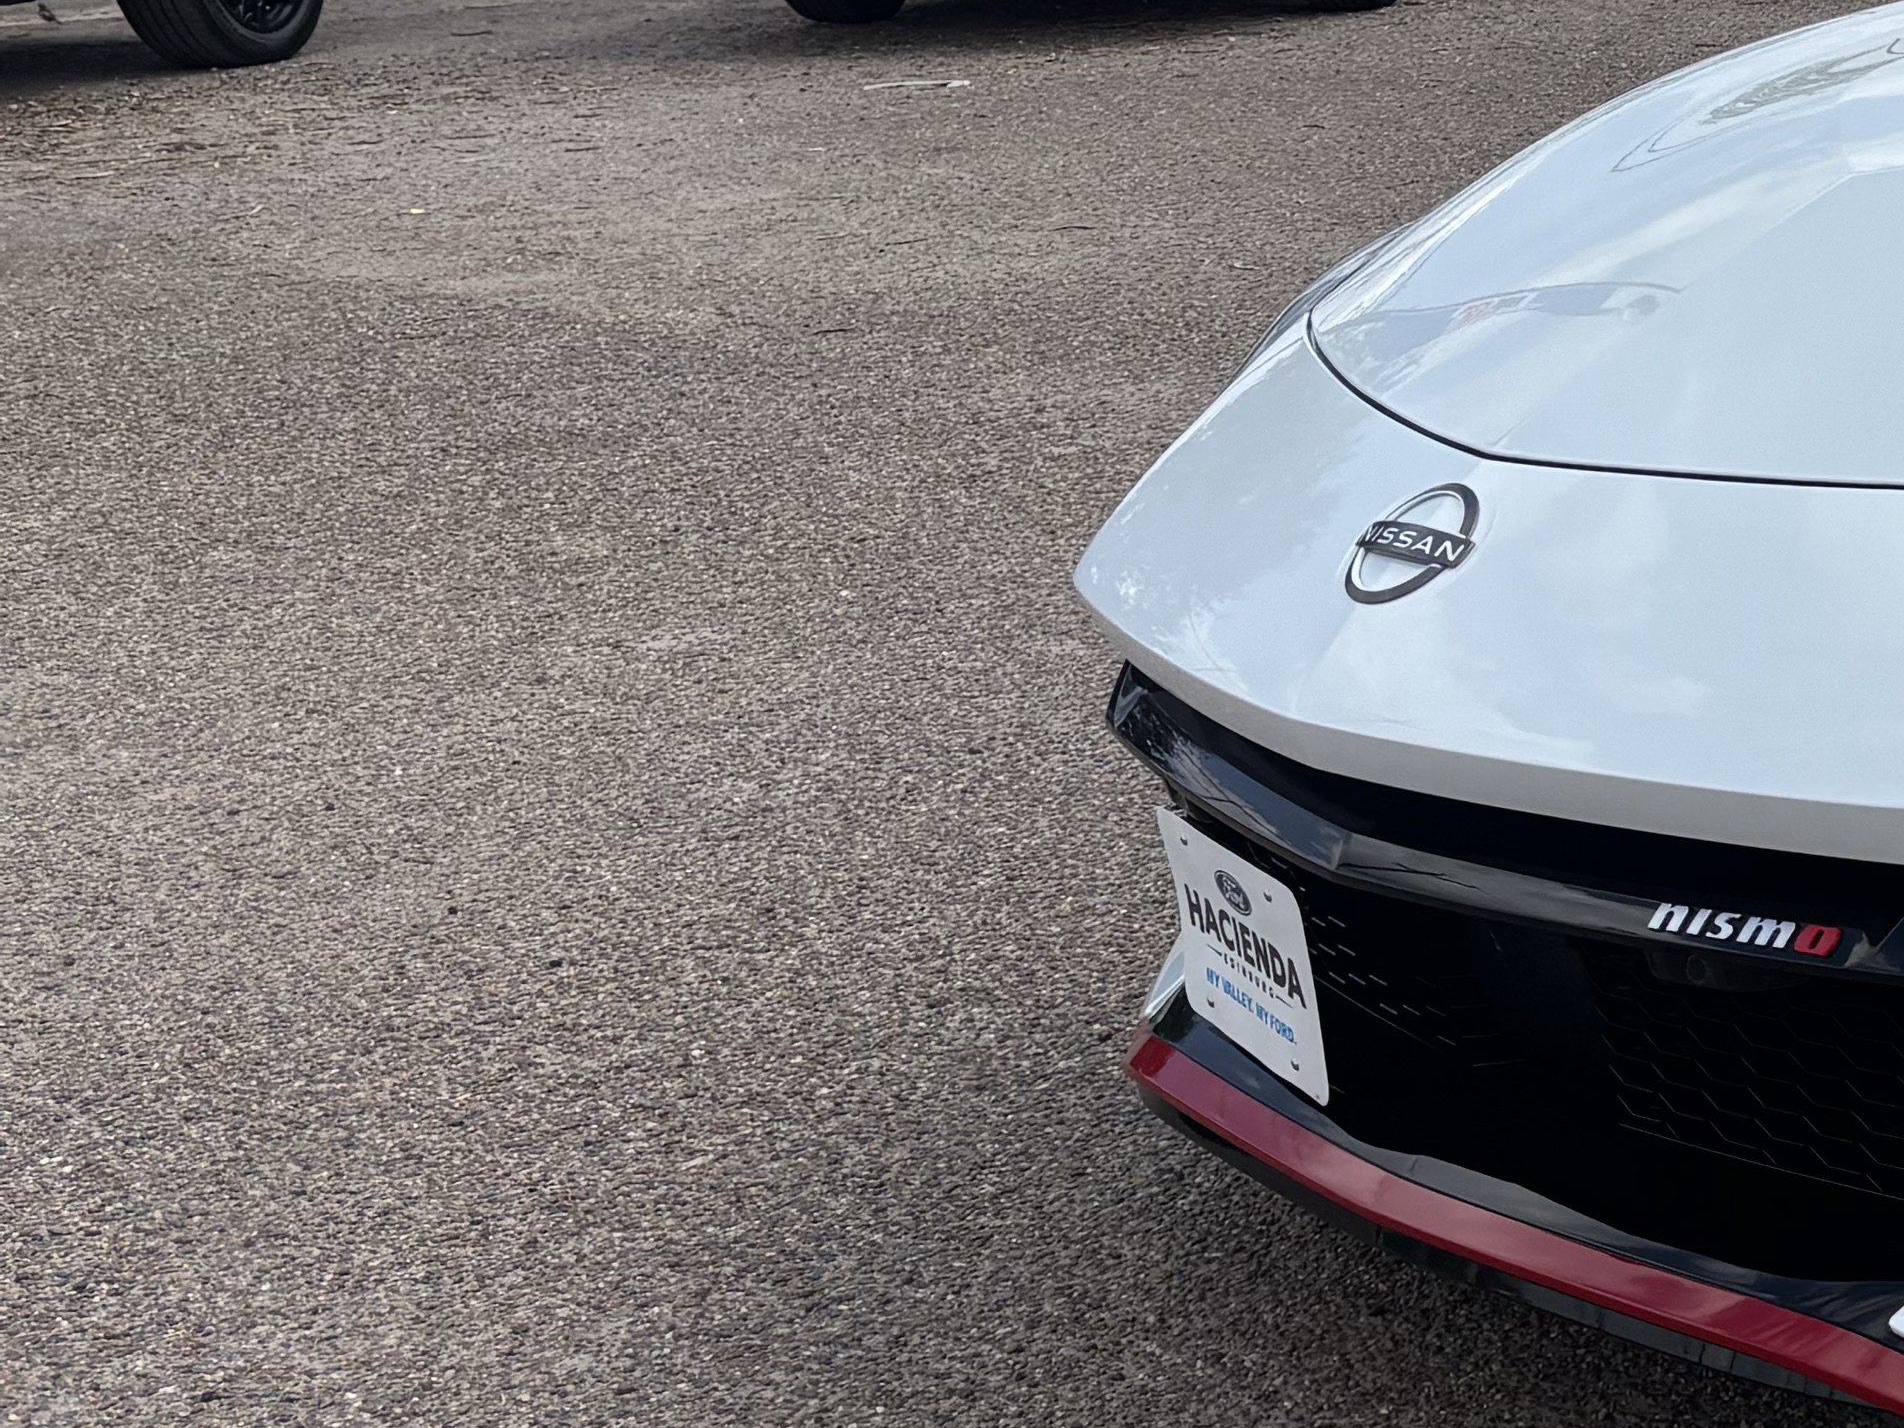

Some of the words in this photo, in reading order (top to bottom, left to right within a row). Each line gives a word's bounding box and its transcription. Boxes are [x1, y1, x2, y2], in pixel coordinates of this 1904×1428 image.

[1363, 525, 1465, 562] NISSAN
[1184, 883, 1307, 1010] HACIENDA
[1206, 967, 1219, 988] MY
[1255, 1003, 1269, 1026] MY
